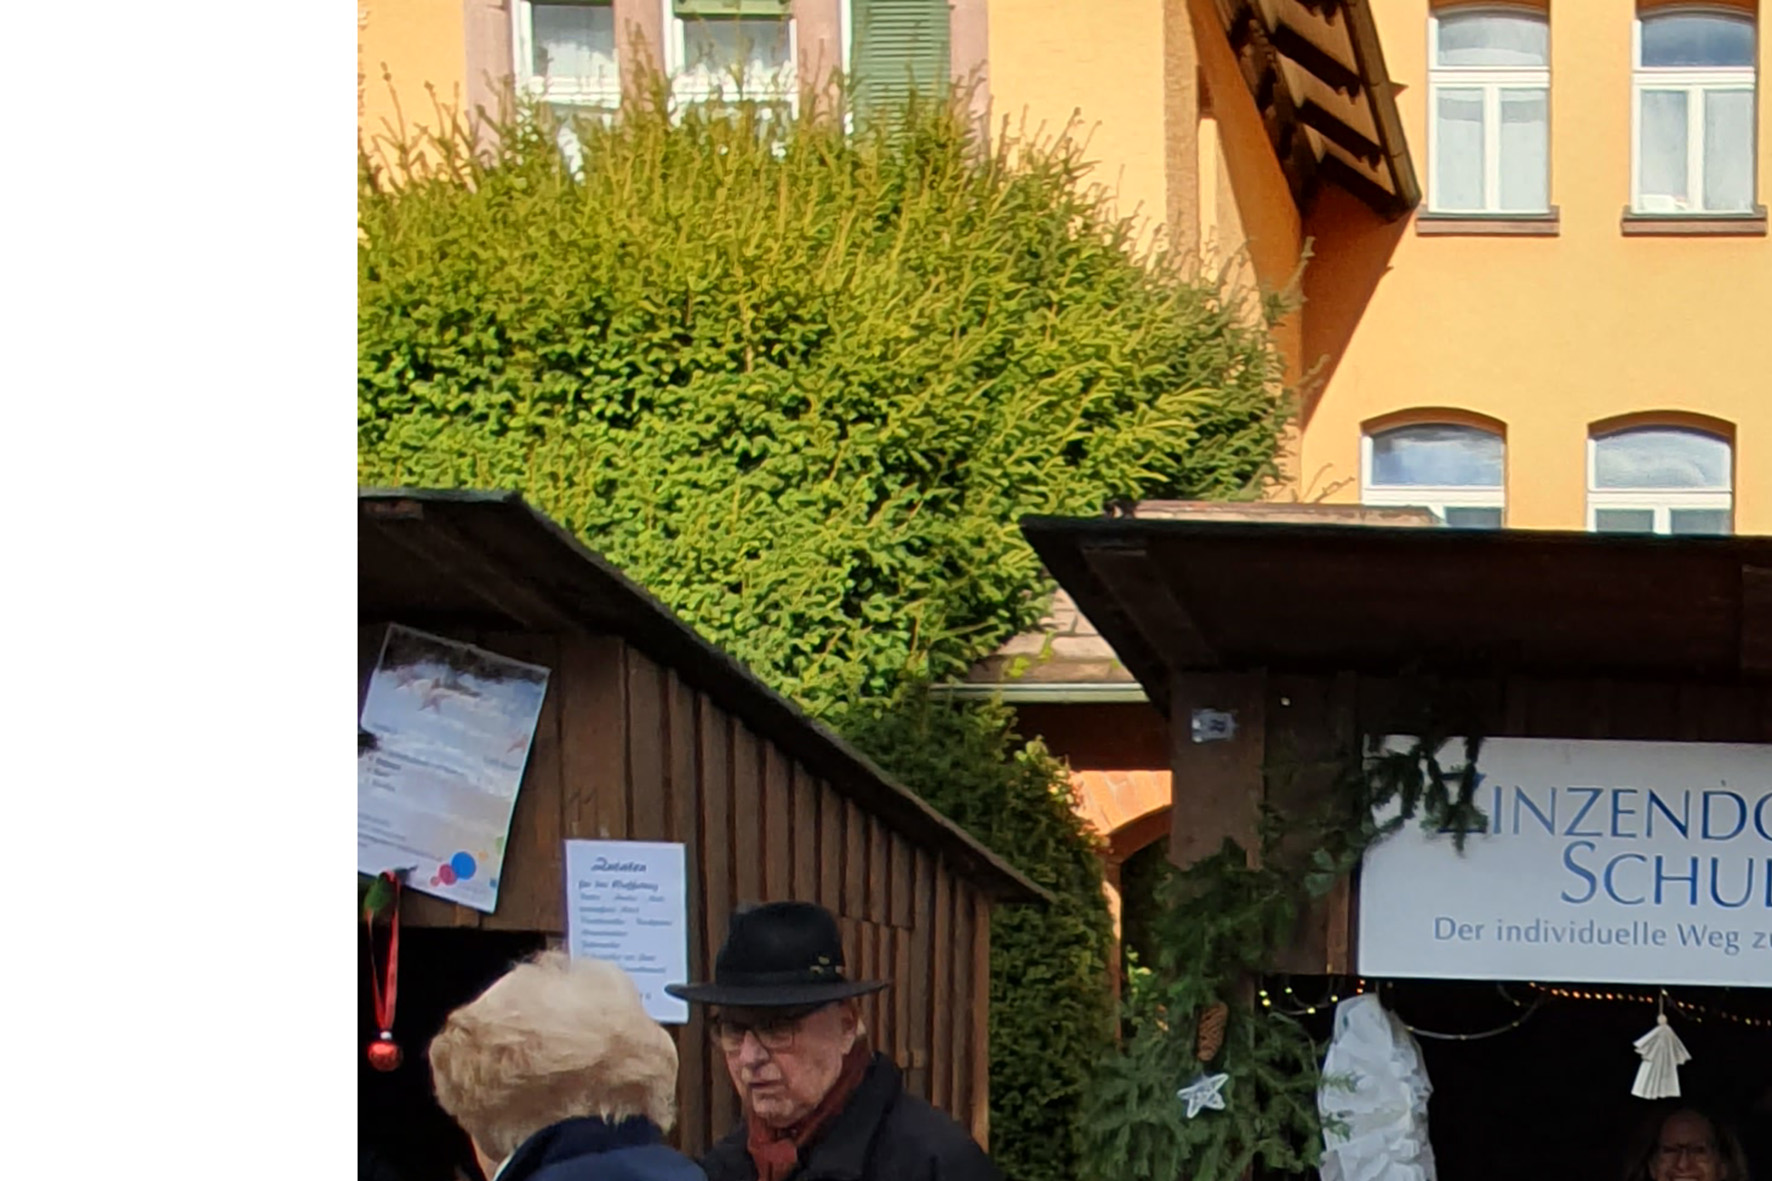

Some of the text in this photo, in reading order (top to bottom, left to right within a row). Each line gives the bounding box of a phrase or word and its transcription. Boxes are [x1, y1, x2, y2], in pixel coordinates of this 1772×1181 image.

[1433, 916, 1485, 941] Der
[1496, 917, 1667, 946] individuelle
[1677, 922, 1740, 956] Weg
